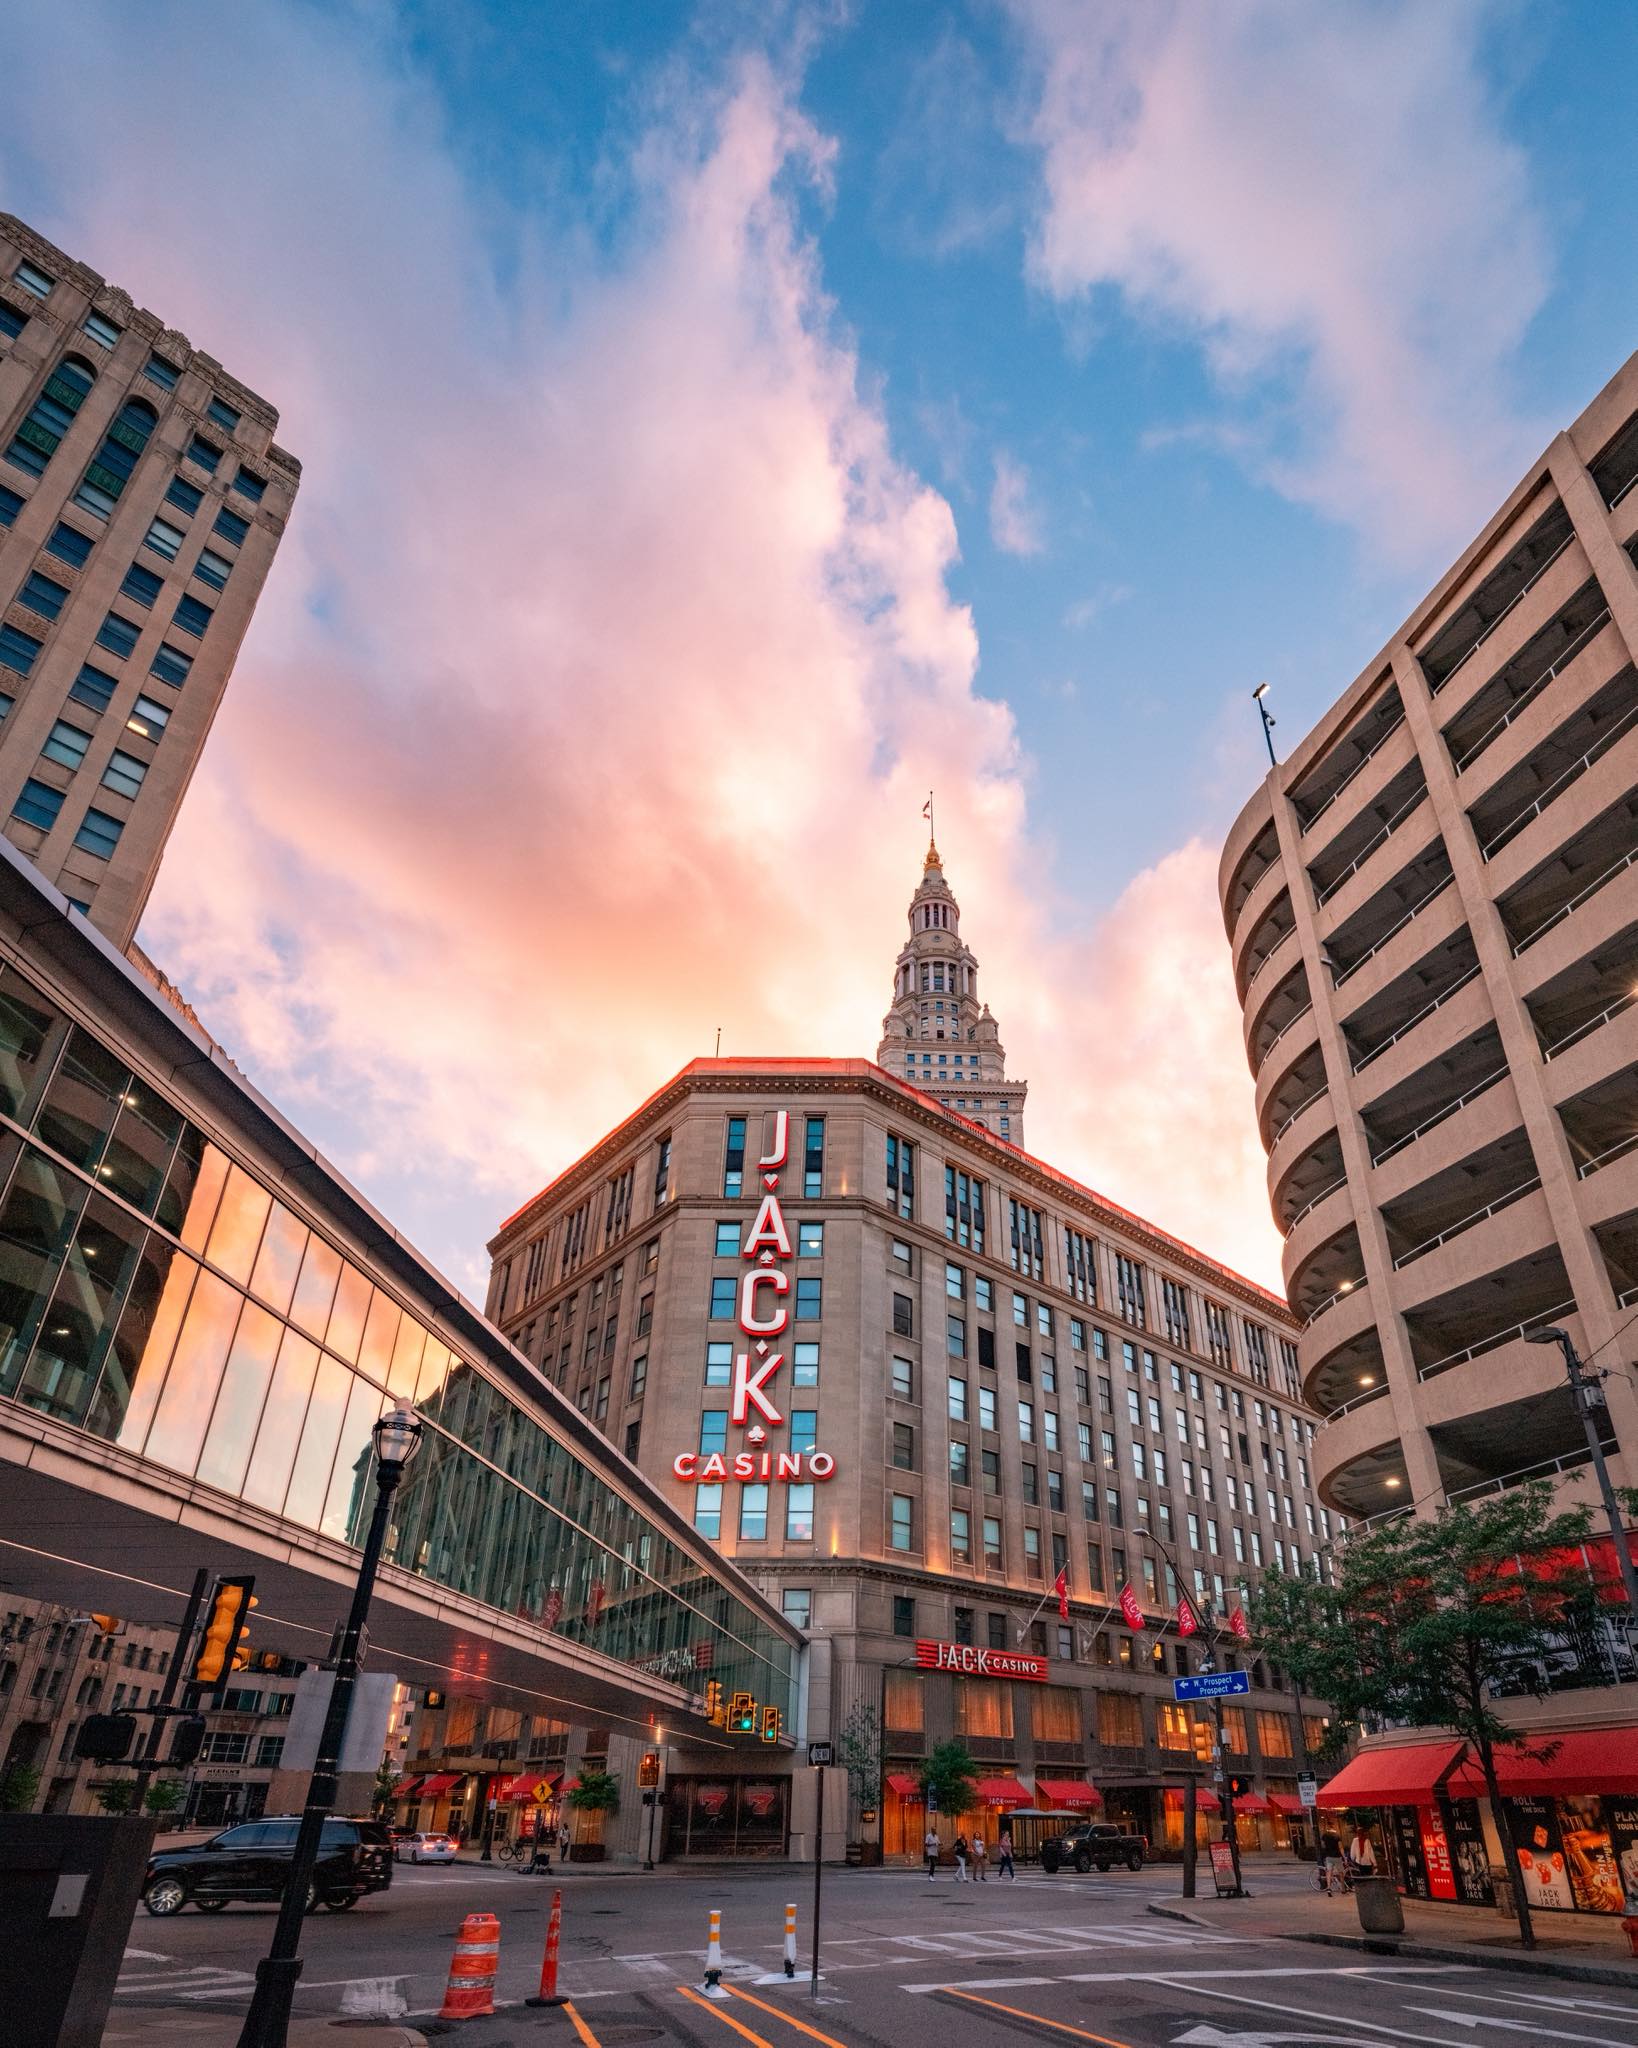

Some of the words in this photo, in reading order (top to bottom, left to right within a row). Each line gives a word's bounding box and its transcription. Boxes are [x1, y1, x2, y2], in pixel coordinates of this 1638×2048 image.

[734, 1110, 792, 1424] JACK
[673, 1453, 836, 1482] CASINO
[936, 1644, 990, 1674] JACK
[993, 1658, 1038, 1673] CASINO
[1200, 1686, 1228, 1695] Prospect
[1203, 1676, 1233, 1687] Prospect
[1424, 1834, 1438, 1871] THE
[1430, 1809, 1450, 1871] HEART
[1539, 1888, 1560, 1897] JACK
[1540, 1898, 1561, 1906] JACK
